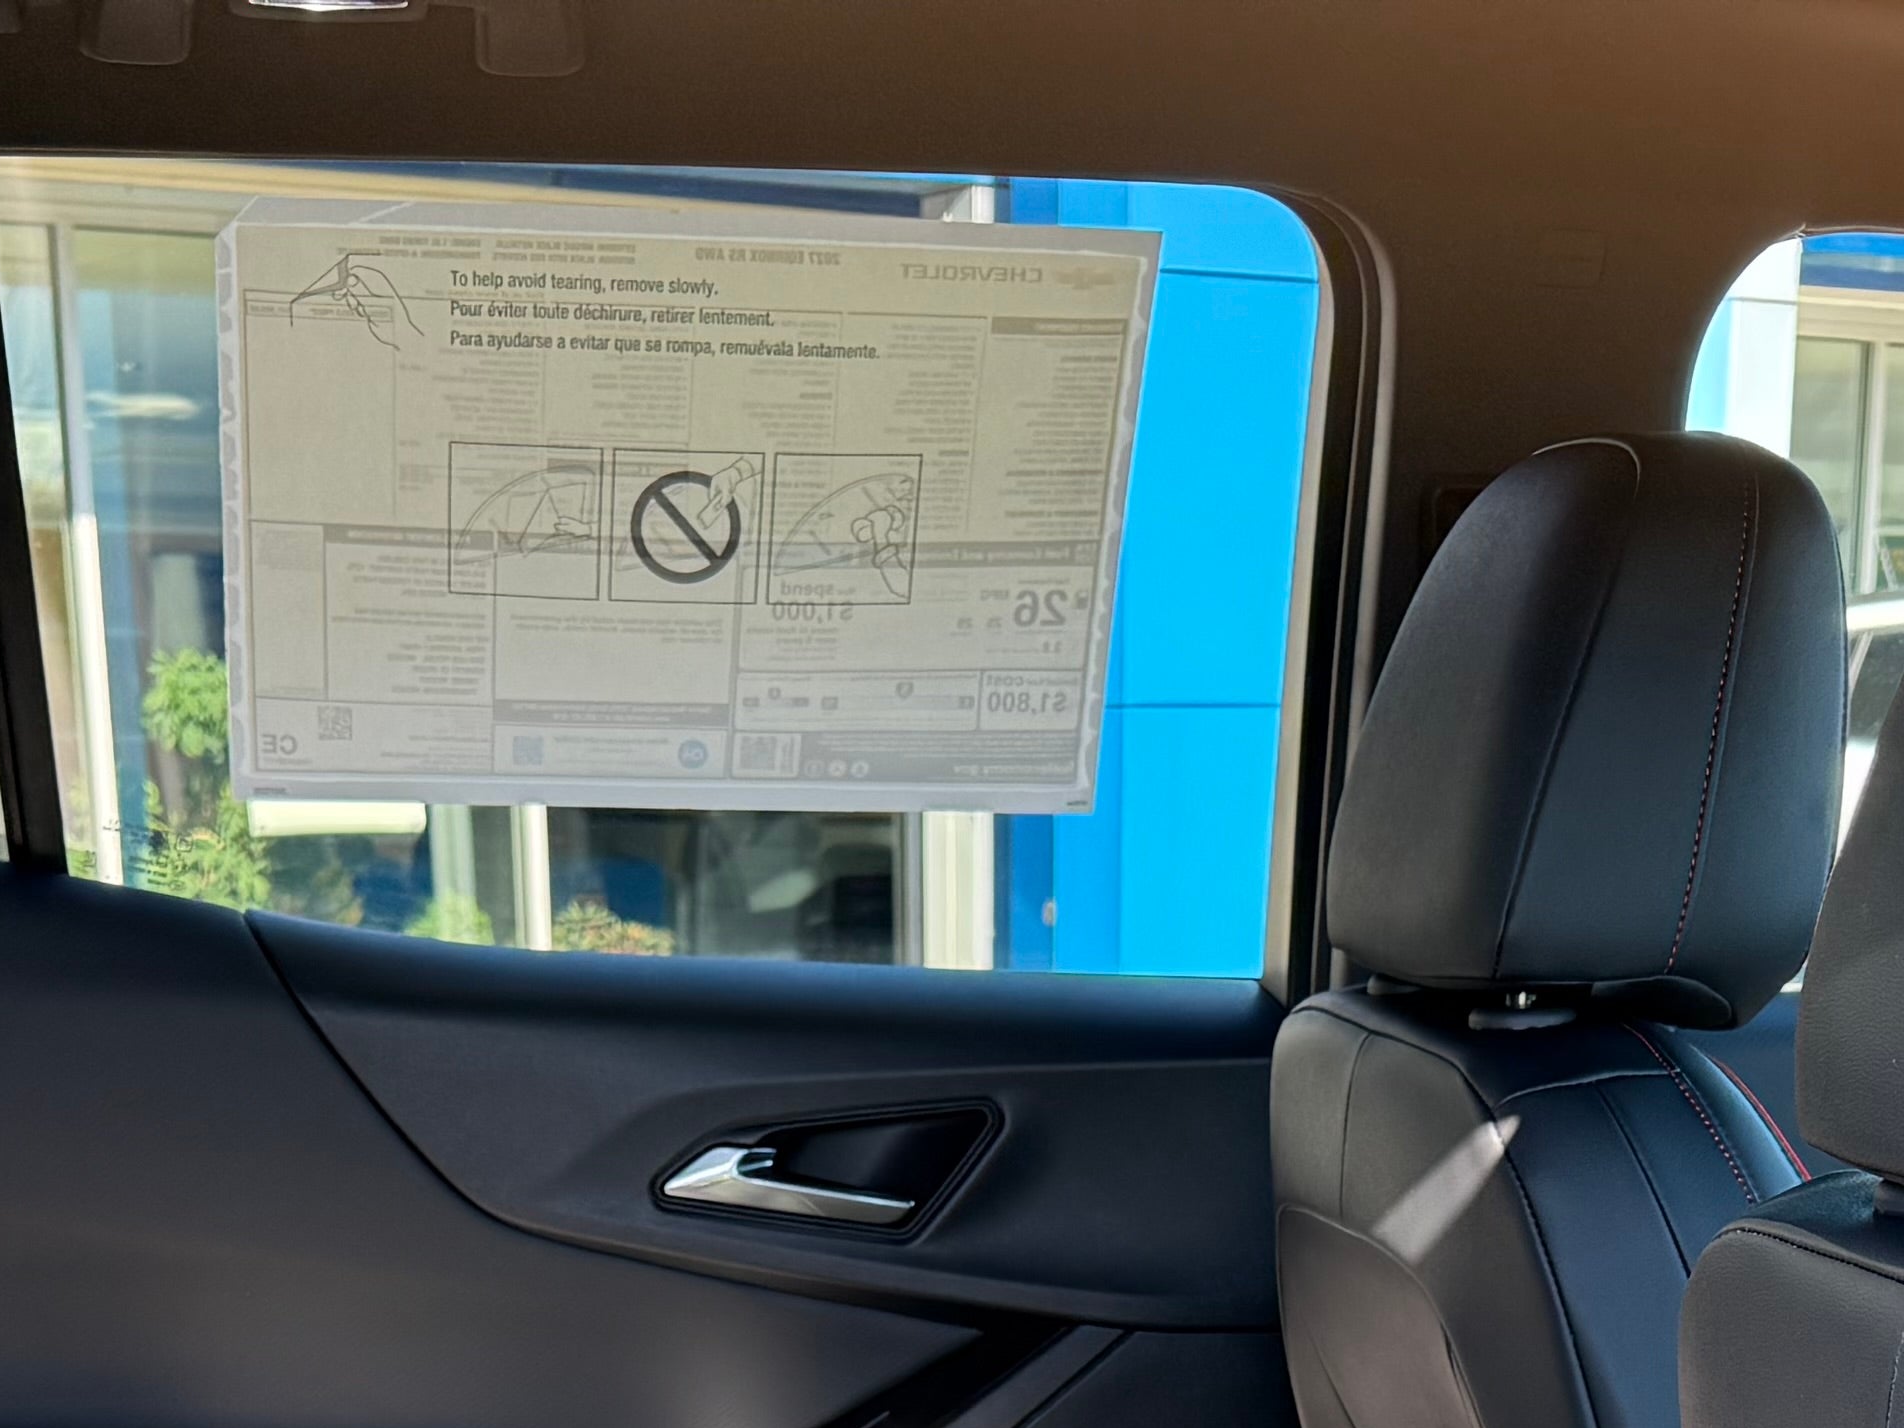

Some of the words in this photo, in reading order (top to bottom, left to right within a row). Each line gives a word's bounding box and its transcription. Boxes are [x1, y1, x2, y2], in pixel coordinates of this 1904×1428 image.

[450, 269, 468, 287] To
[472, 270, 503, 290] help
[507, 273, 546, 289] avoid
[550, 274, 606, 294] tearing,
[610, 278, 664, 293] remove
[668, 278, 718, 298] slowly.
[450, 299, 483, 317] Pour
[487, 300, 527, 318] éviter
[533, 301, 569, 319] toute
[573, 303, 647, 324] déchirure,
[651, 306, 695, 324] retirer
[699, 307, 774, 327] lentement.
[450, 330, 483, 347] Para
[487, 332, 553, 351] ayudarse
[556, 336, 566, 349] a
[570, 336, 610, 350] evitar
[614, 338, 641, 355] que
[645, 339, 662, 353] se
[666, 340, 716, 357] rompa,
[720, 339, 794, 357] remuévala
[797, 341, 880, 359] lentamente.
